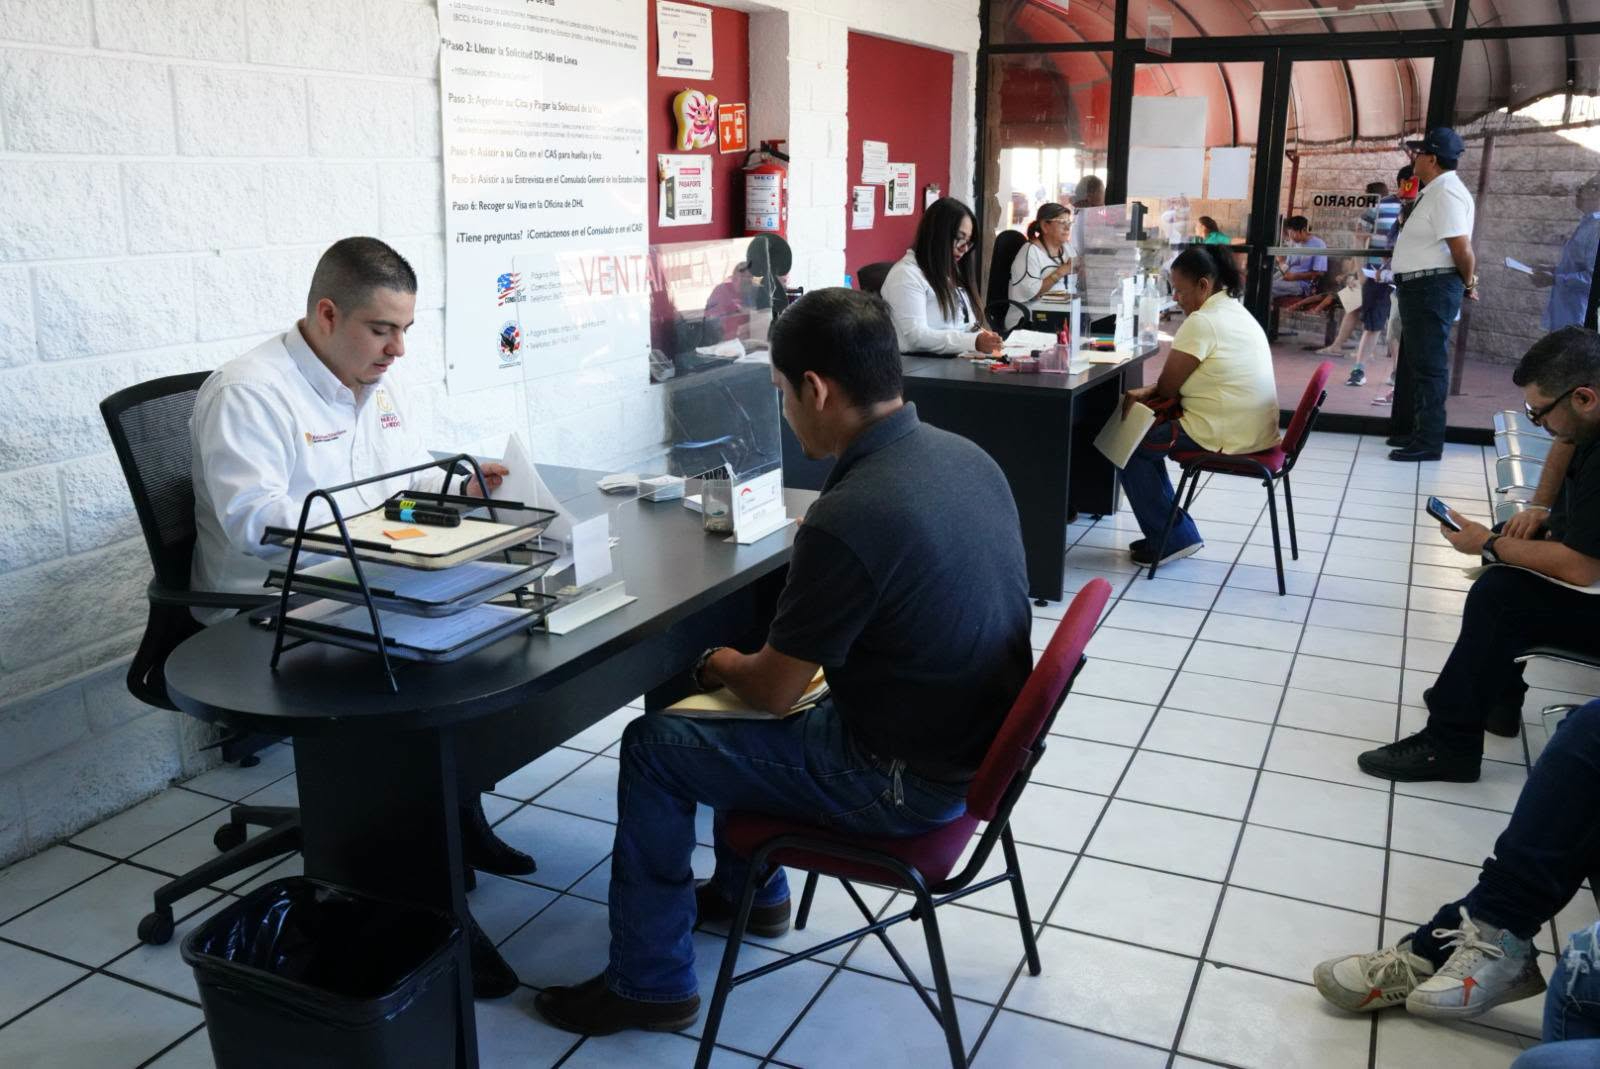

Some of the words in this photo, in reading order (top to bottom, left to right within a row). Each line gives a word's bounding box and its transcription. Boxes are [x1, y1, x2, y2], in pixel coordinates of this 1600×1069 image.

[446, 40, 464, 51] Paso
[466, 41, 472, 52] 2:
[474, 43, 496, 55] Llenar
[498, 46, 504, 55] la
[505, 47, 533, 59] Solicitud
[534, 51, 555, 63] DS-160
[556, 55, 563, 63] en
[448, 92, 466, 104] Paso
[467, 94, 475, 104] 3:
[475, 95, 504, 107] Agendar
[515, 98, 528, 108] Cita
[534, 100, 551, 111] Pagar
[558, 102, 580, 112] Solicitud
[450, 146, 467, 156] Paso
[477, 147, 498, 157] Asistir
[514, 148, 527, 158] Cita
[529, 150, 537, 158] en
[544, 149, 557, 159] CAS
[558, 151, 570, 161] para
[571, 150, 588, 160] huellas
[452, 174, 469, 183] Paso
[478, 174, 499, 184] Asistir
[515, 174, 544, 184] Entrevista
[560, 175, 587, 184] Consulado
[588, 175, 605, 184] General
[618, 174, 633, 184] Estados
[633, 175, 646, 184] Unidos
[453, 202, 469, 210] Paso
[471, 201, 477, 210] 6:
[479, 201, 506, 212] Recoger
[515, 200, 527, 209] Visa
[537, 200, 543, 208] la
[544, 200, 563, 208] Oficina
[564, 200, 571, 208] de
[572, 199, 584, 208] DHL
[572, 229, 579, 237] en
[580, 227, 586, 237] el
[587, 226, 614, 236] Consulado
